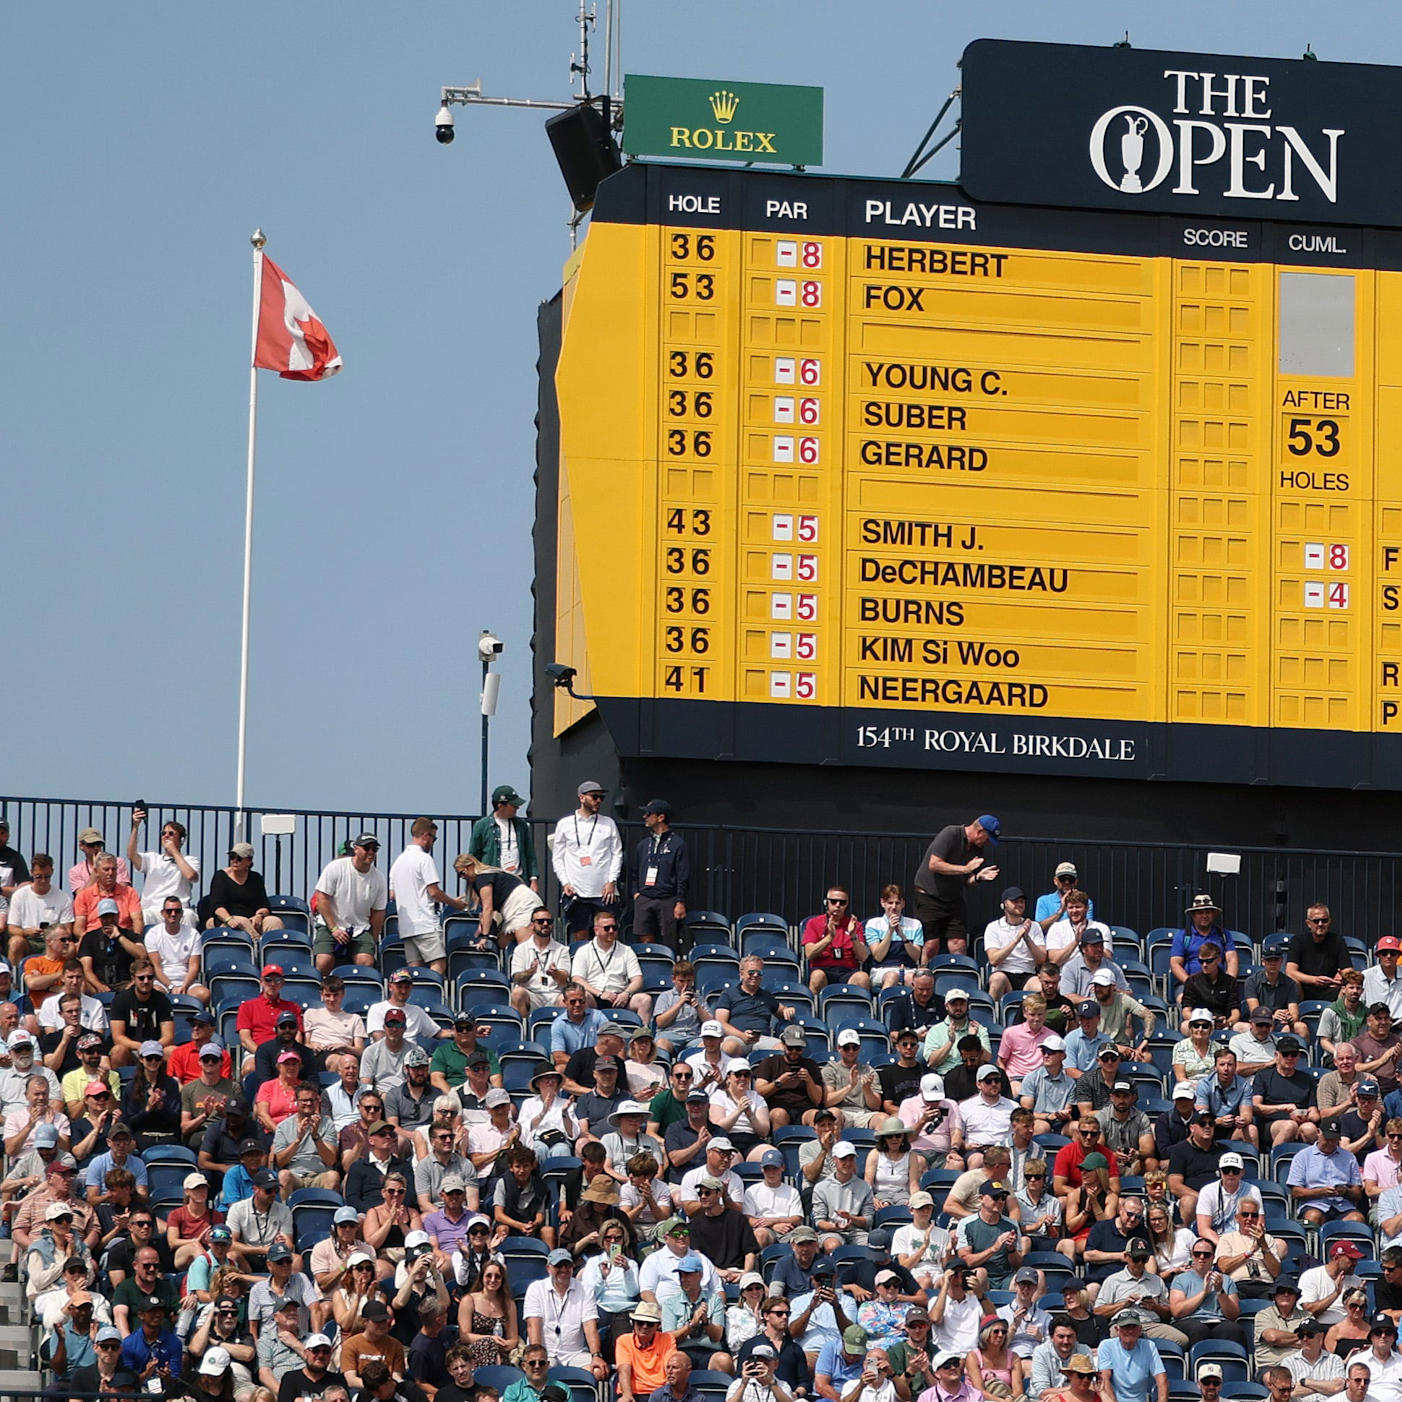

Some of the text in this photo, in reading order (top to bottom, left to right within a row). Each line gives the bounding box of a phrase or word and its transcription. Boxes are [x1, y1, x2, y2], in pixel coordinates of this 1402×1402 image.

[1164, 70, 1272, 119] THE
[671, 128, 776, 152] ROLEX
[1089, 105, 1345, 204] OPEN
[670, 195, 1346, 253] HOLE PAR PLAYER SCORE CUML.
[672, 234, 715, 260] 36
[865, 244, 1008, 277] HERBERT
[671, 273, 715, 300] 53
[866, 286, 927, 311] FOX
[670, 351, 714, 378] 36
[866, 362, 971, 392] YOUNG
[981, 370, 1008, 396] C.
[670, 391, 712, 417] 36
[865, 402, 966, 430] SUBER
[1282, 391, 1350, 411] AFTER
[669, 430, 712, 457] 36
[862, 441, 987, 471] GERARD
[1288, 416, 1343, 457] 53
[1281, 471, 1348, 490] HOLES
[668, 508, 710, 535] 43
[862, 519, 954, 549] SMITH
[959, 524, 986, 550] J.
[667, 548, 711, 575] 36
[862, 558, 1072, 592] DeCHAMBEAU
[667, 587, 710, 614] 36
[861, 597, 964, 626] BURNS
[666, 626, 708, 653] 36
[859, 636, 915, 662] KIM
[920, 639, 948, 664] Si
[954, 641, 1019, 667] Woo
[666, 666, 709, 692] 41
[858, 676, 1048, 708] NEERGAARD
[858, 727, 1135, 760] 154TH ROYAL BIRKDALE
